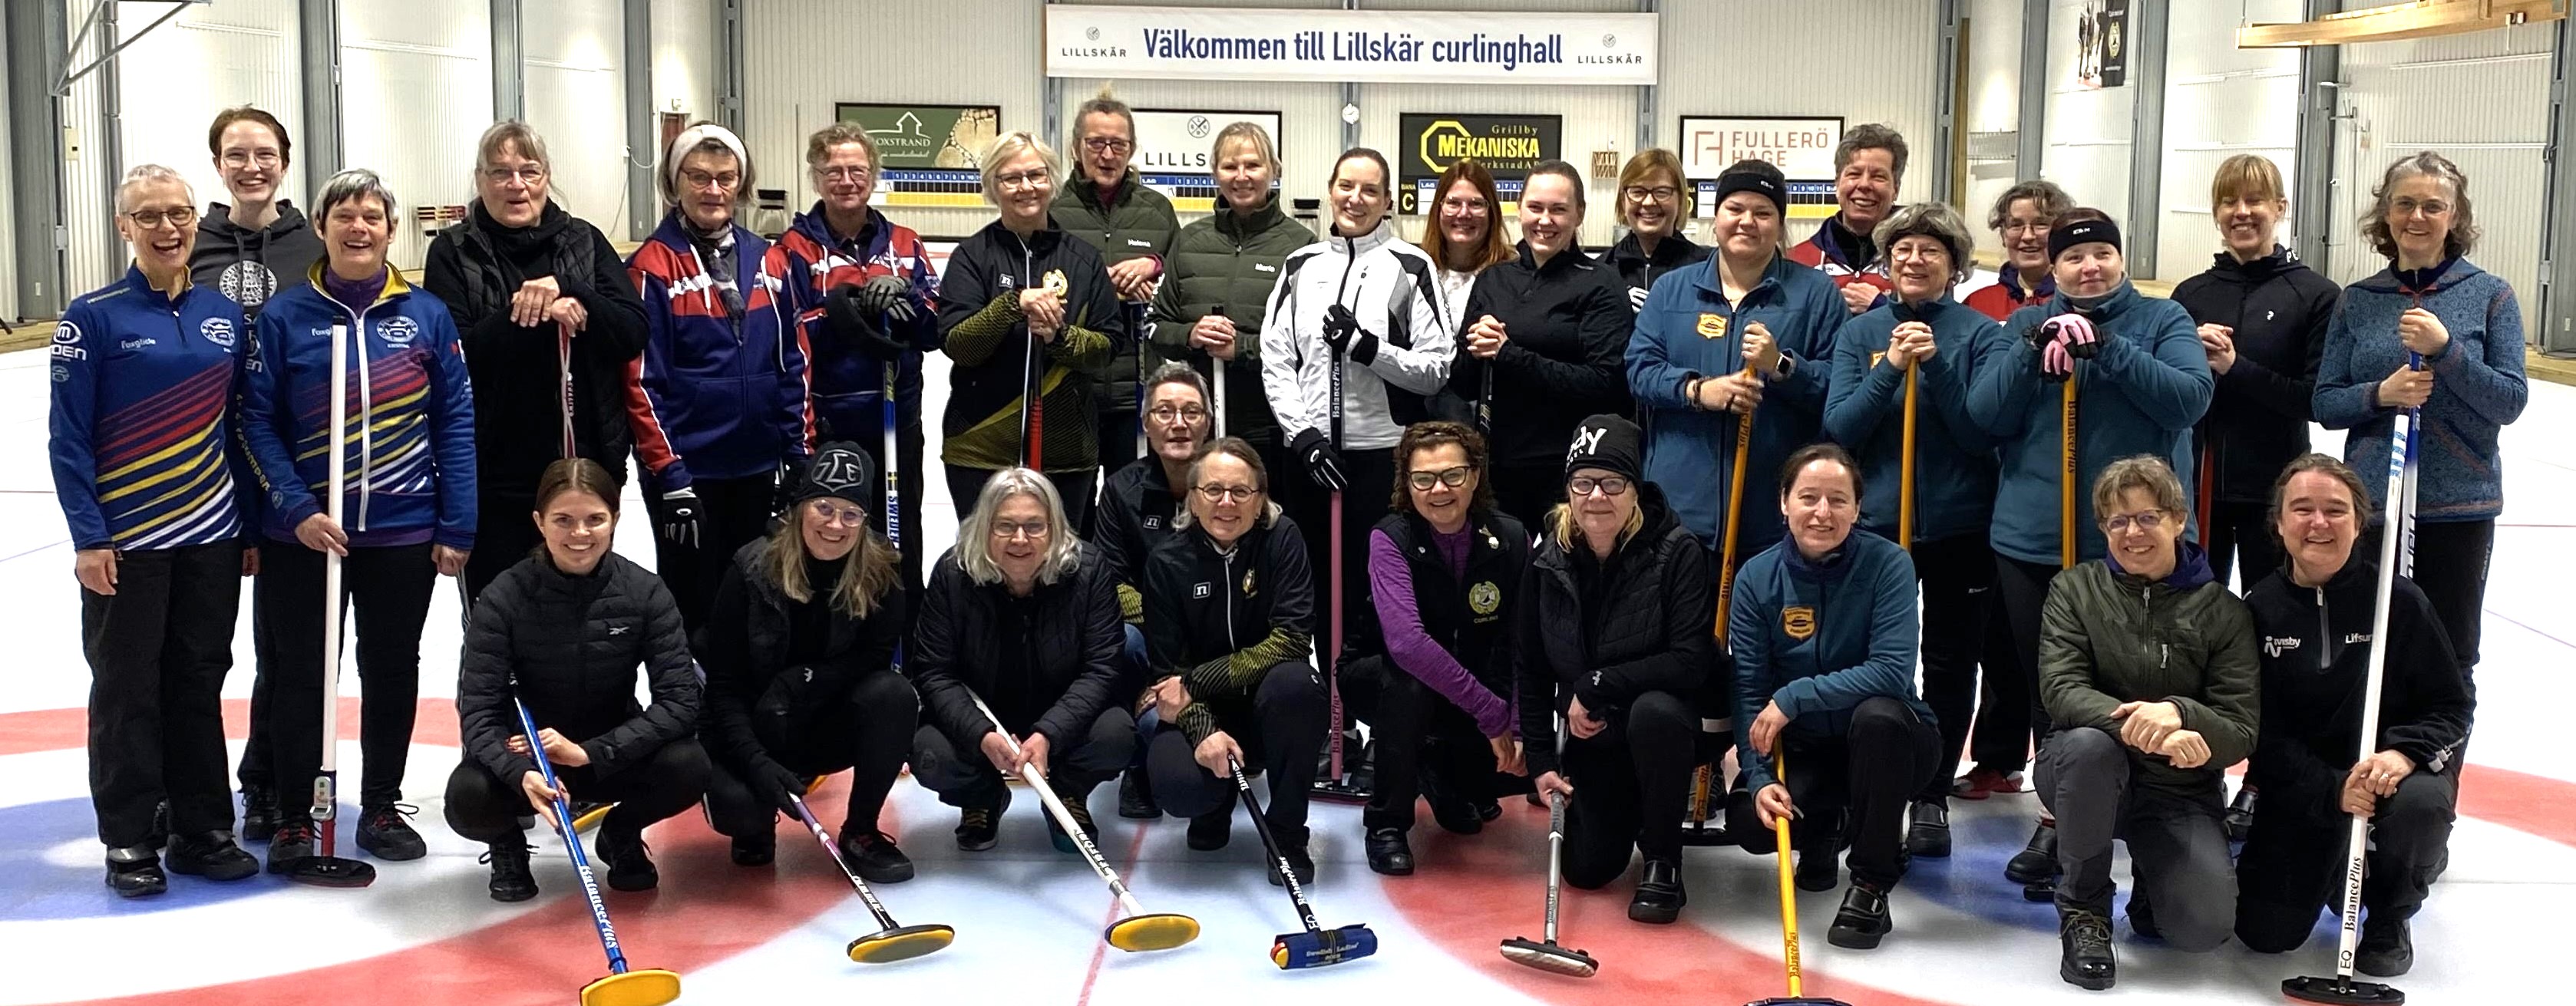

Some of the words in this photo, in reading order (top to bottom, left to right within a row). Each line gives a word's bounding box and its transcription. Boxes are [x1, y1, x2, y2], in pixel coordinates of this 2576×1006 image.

[1062, 47, 1127, 58] LILLSKÄR
[1144, 28, 1286, 60] Välkommen
[1294, 31, 1326, 61] till
[1333, 31, 1424, 63] Lillskär
[1432, 34, 1563, 71] curlinghall
[1577, 53, 1643, 64] LILLSKÄR
[1491, 124, 1539, 137] Grillby
[1732, 127, 1828, 149] FULLERÖ
[876, 137, 931, 147] OXSTRAND
[1438, 134, 1541, 159] MEKANISKA
[1144, 152, 1207, 167] LILLS
[1402, 193, 1415, 212] C
[2343, 856, 2363, 932] BalancePlus
[2340, 950, 2353, 970] EQ
